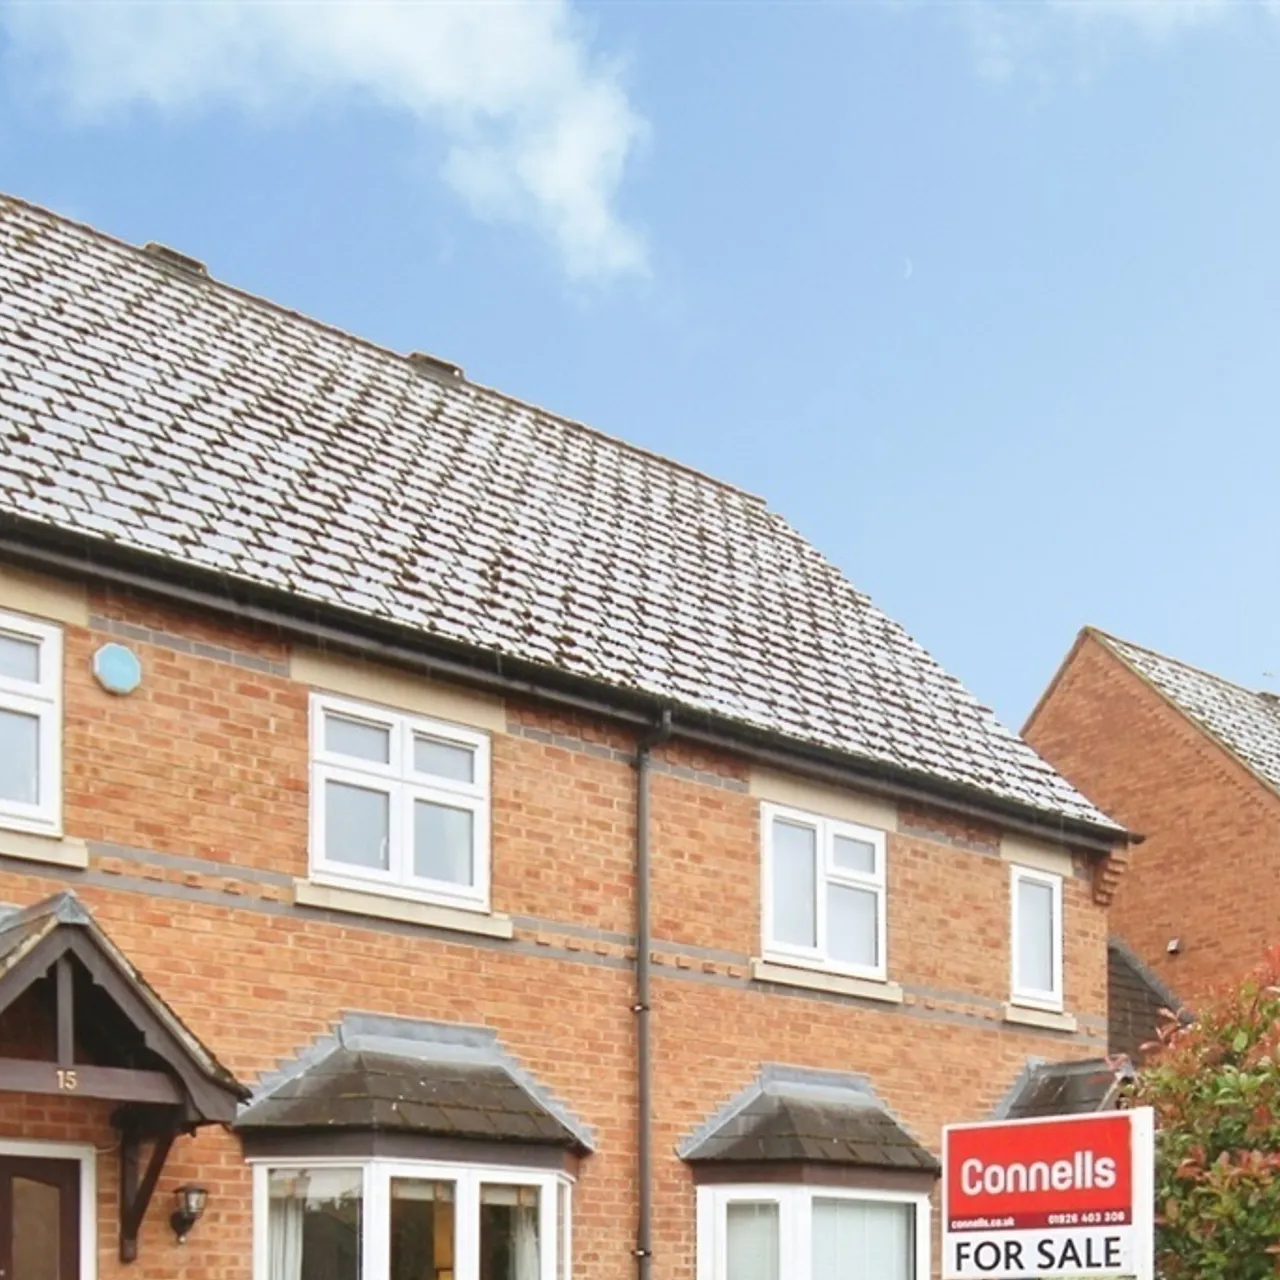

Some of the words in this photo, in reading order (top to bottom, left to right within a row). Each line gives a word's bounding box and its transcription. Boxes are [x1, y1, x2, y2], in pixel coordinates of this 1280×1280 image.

[56, 1070, 77, 1091] 15
[961, 1150, 1116, 1196] Connells
[955, 1240, 1024, 1272] FOR
[1037, 1236, 1122, 1270] SALE
